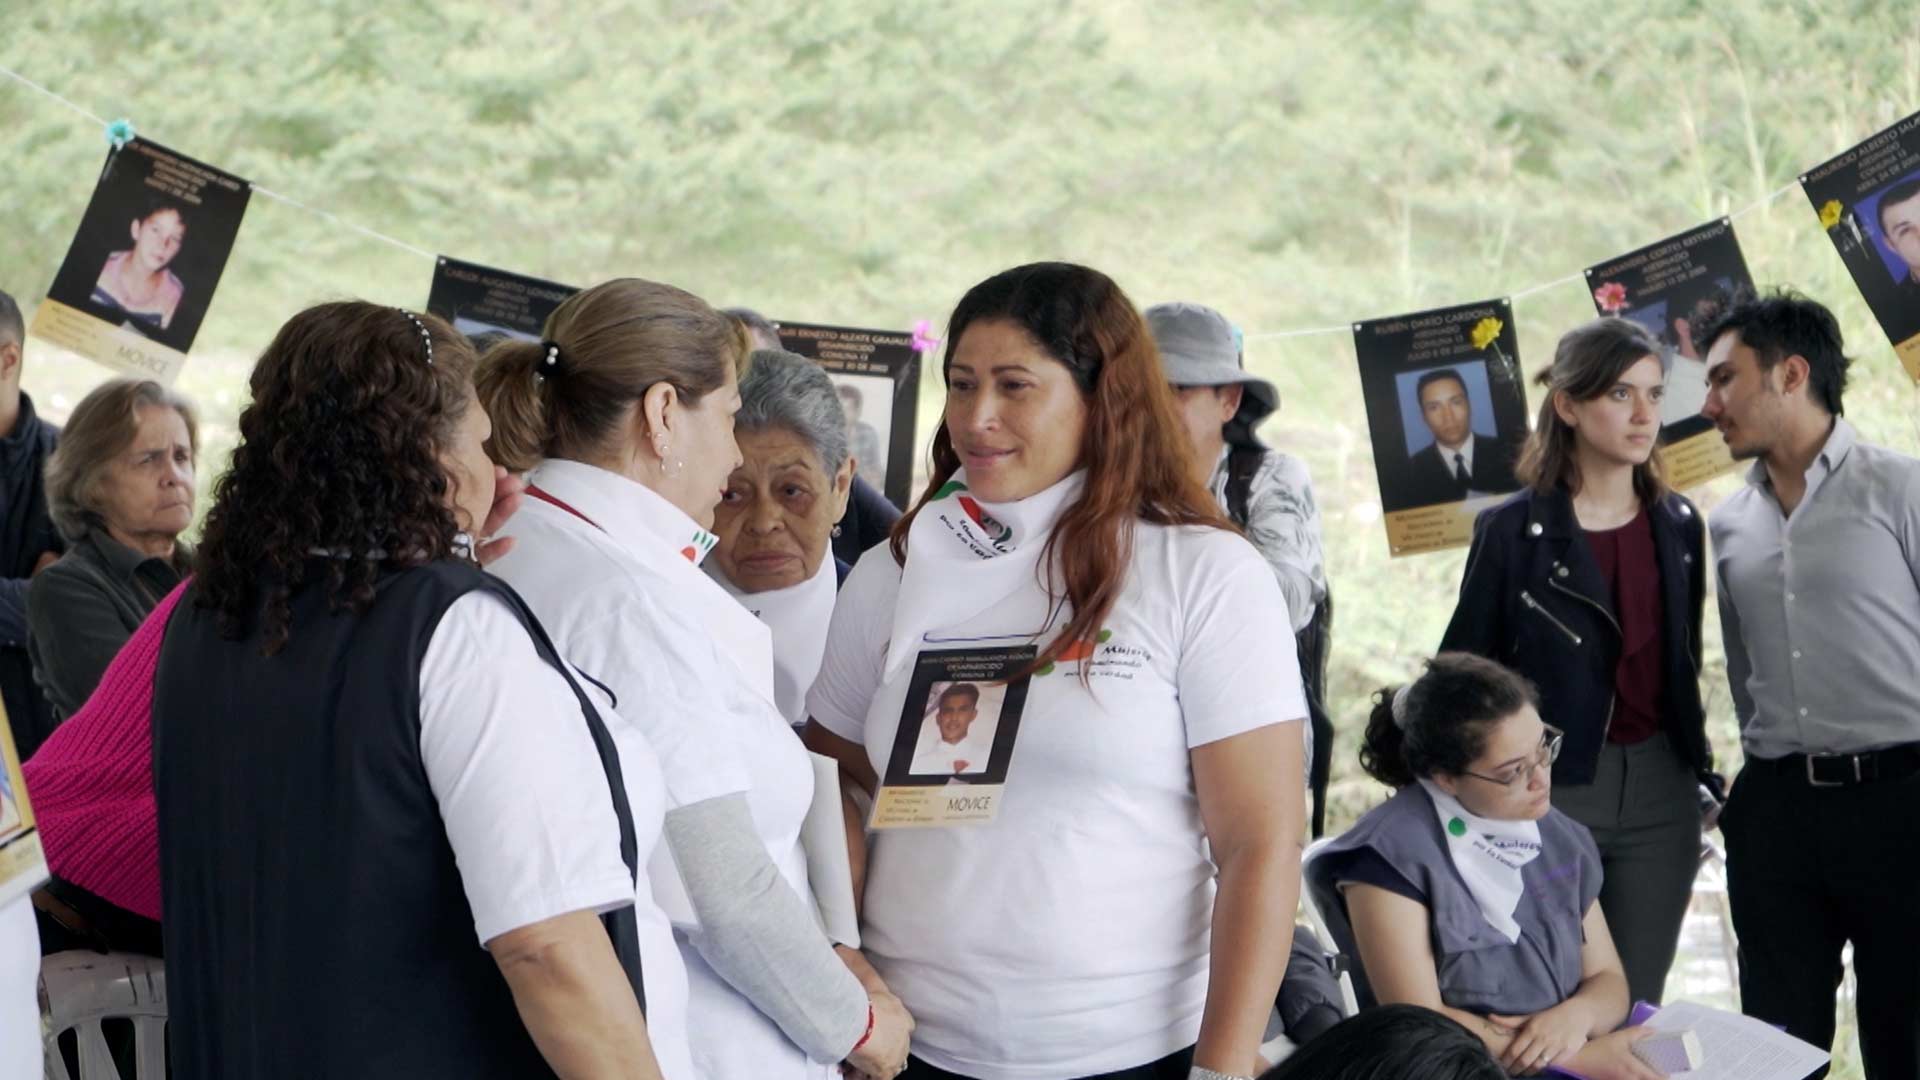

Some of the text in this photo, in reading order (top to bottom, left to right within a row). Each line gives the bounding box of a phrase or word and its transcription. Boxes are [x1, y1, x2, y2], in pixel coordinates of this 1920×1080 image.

[1859, 129, 1898, 157] ALBERTO
[1444, 307, 1495, 323] CARDONA
[946, 796, 991, 812] MOVICE
